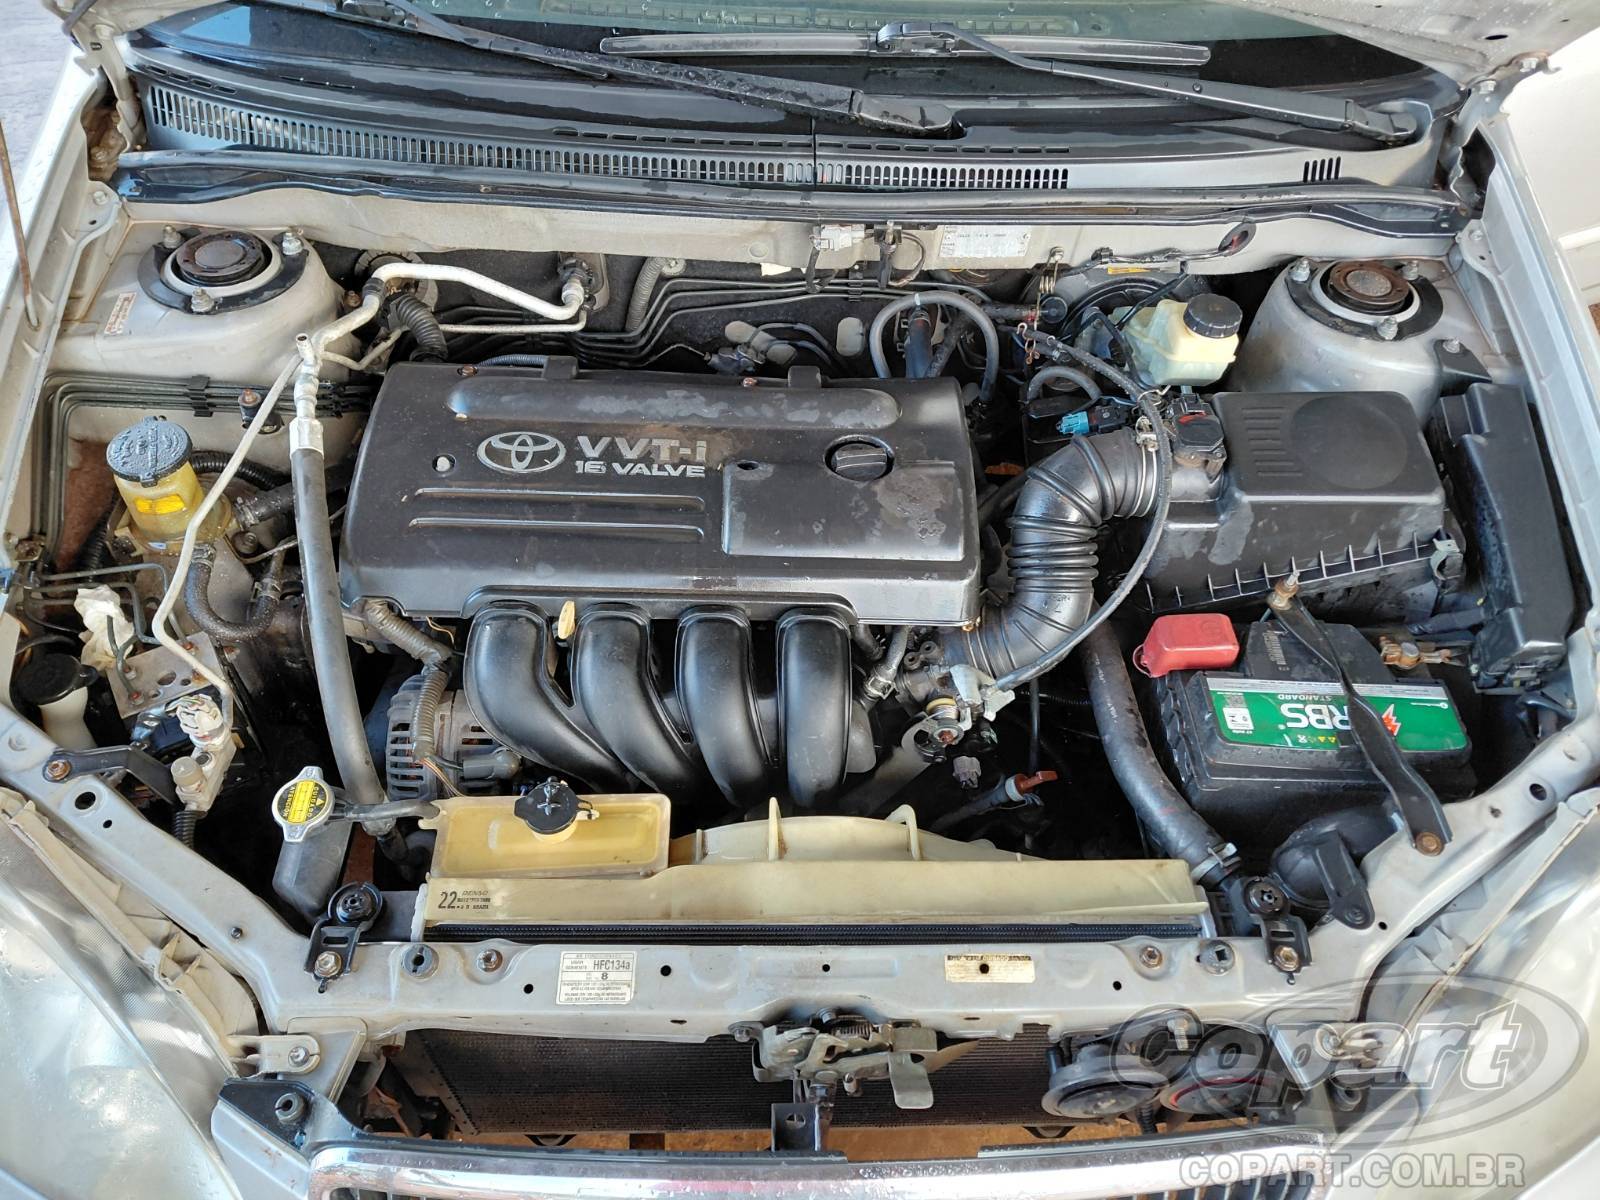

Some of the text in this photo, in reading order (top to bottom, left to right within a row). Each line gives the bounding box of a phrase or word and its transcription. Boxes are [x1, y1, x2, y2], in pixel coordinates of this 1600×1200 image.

[575, 460, 706, 478] 16 VALVE
[593, 959, 631, 971] HFC134a
[600, 972, 609, 981] 8
